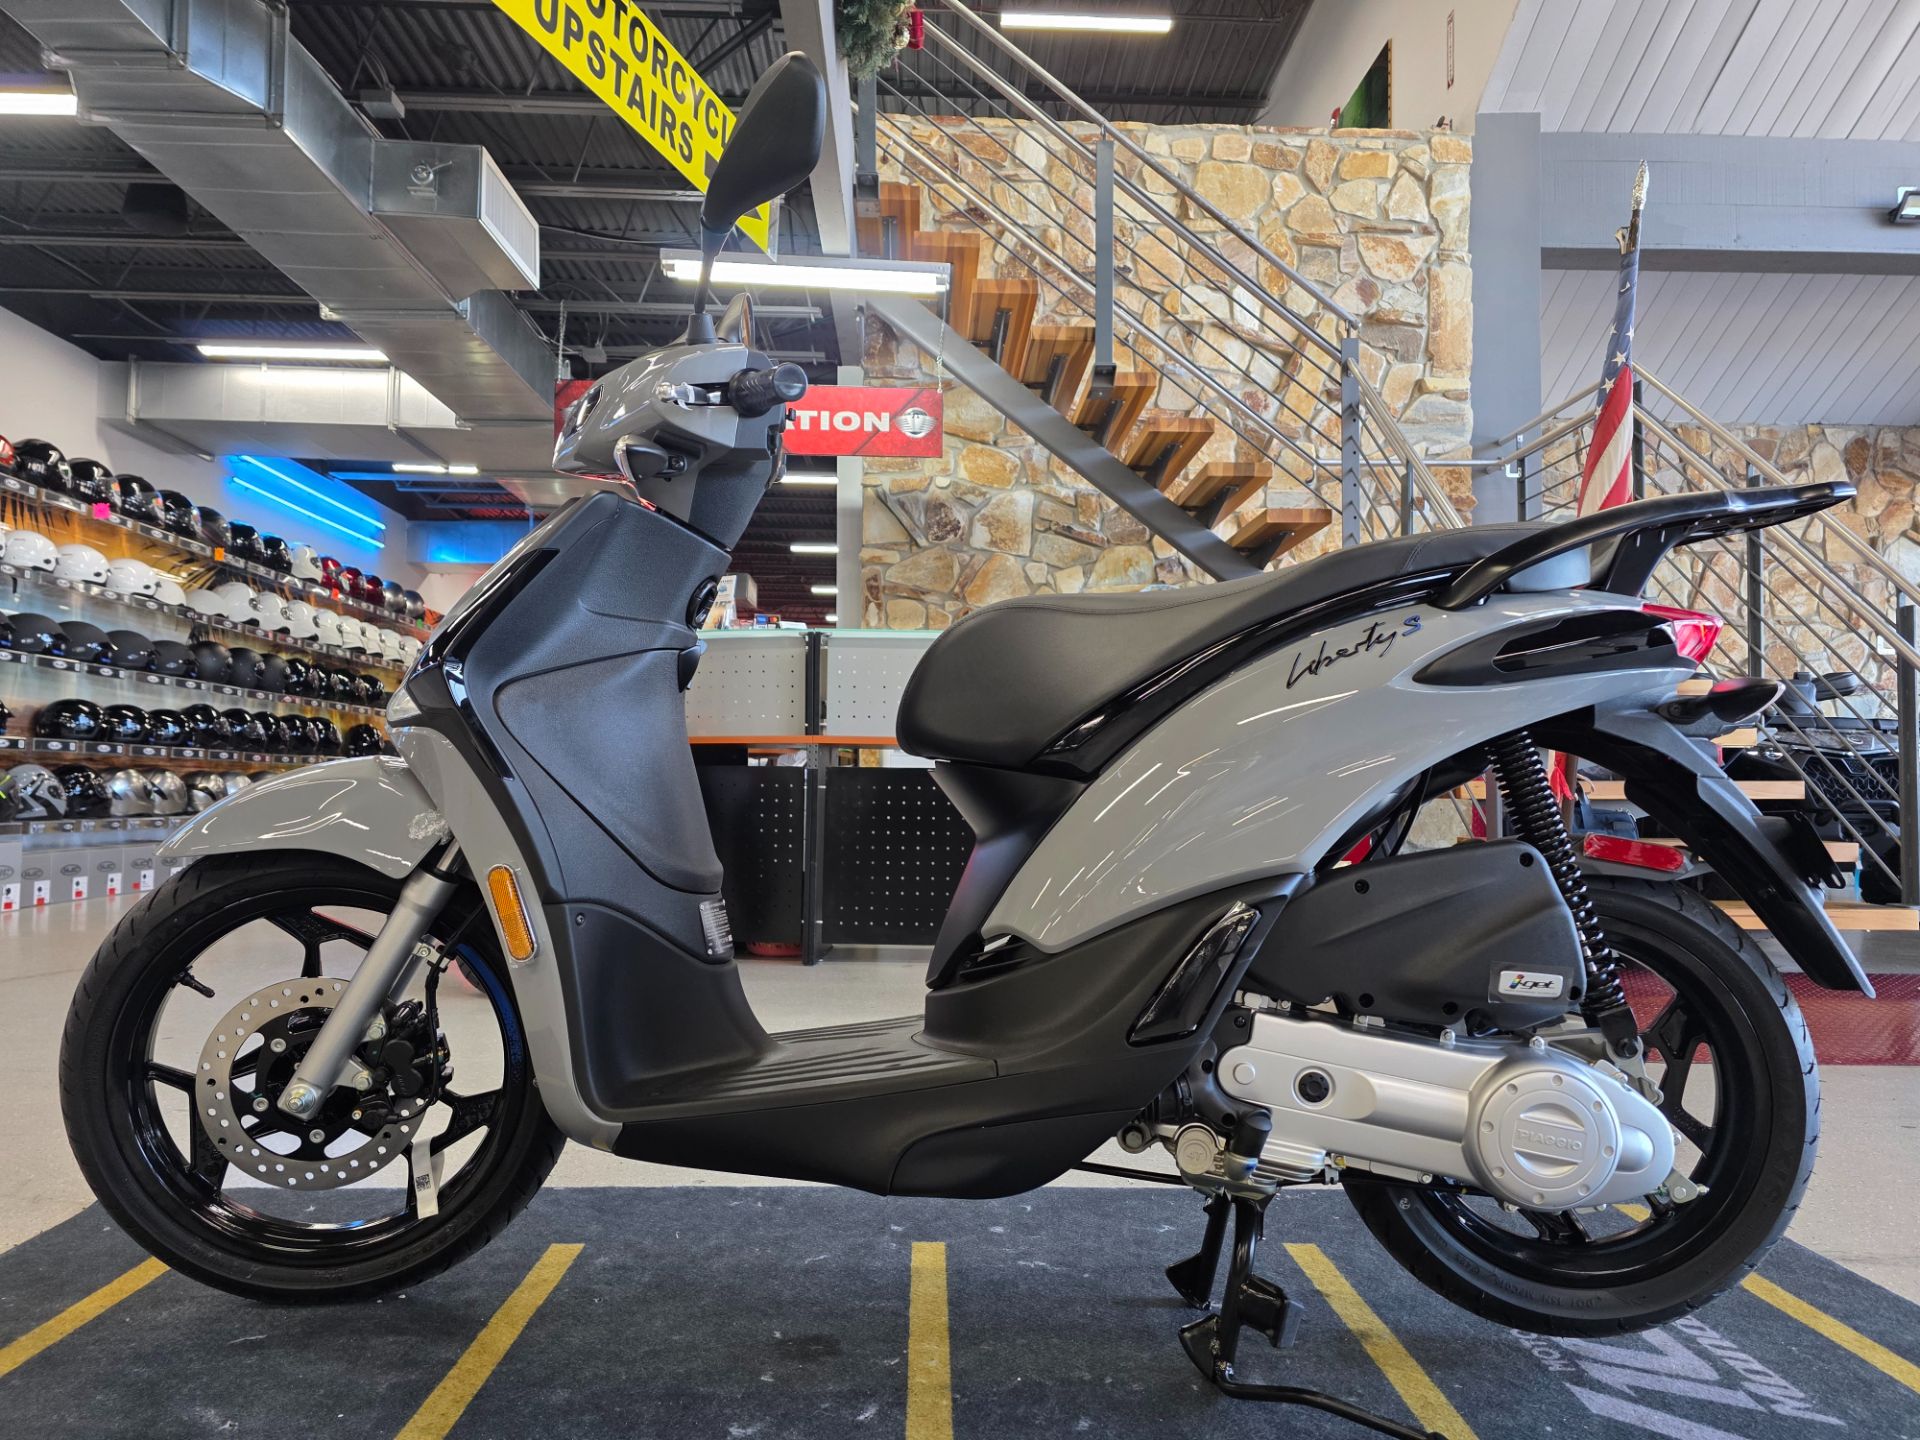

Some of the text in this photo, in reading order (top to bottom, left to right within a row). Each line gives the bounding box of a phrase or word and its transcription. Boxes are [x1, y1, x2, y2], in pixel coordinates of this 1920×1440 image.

[533, 0, 694, 165] UPSTAIRS
[785, 409, 891, 433] TION
[1515, 1128, 1583, 1152] PIAGGIO
